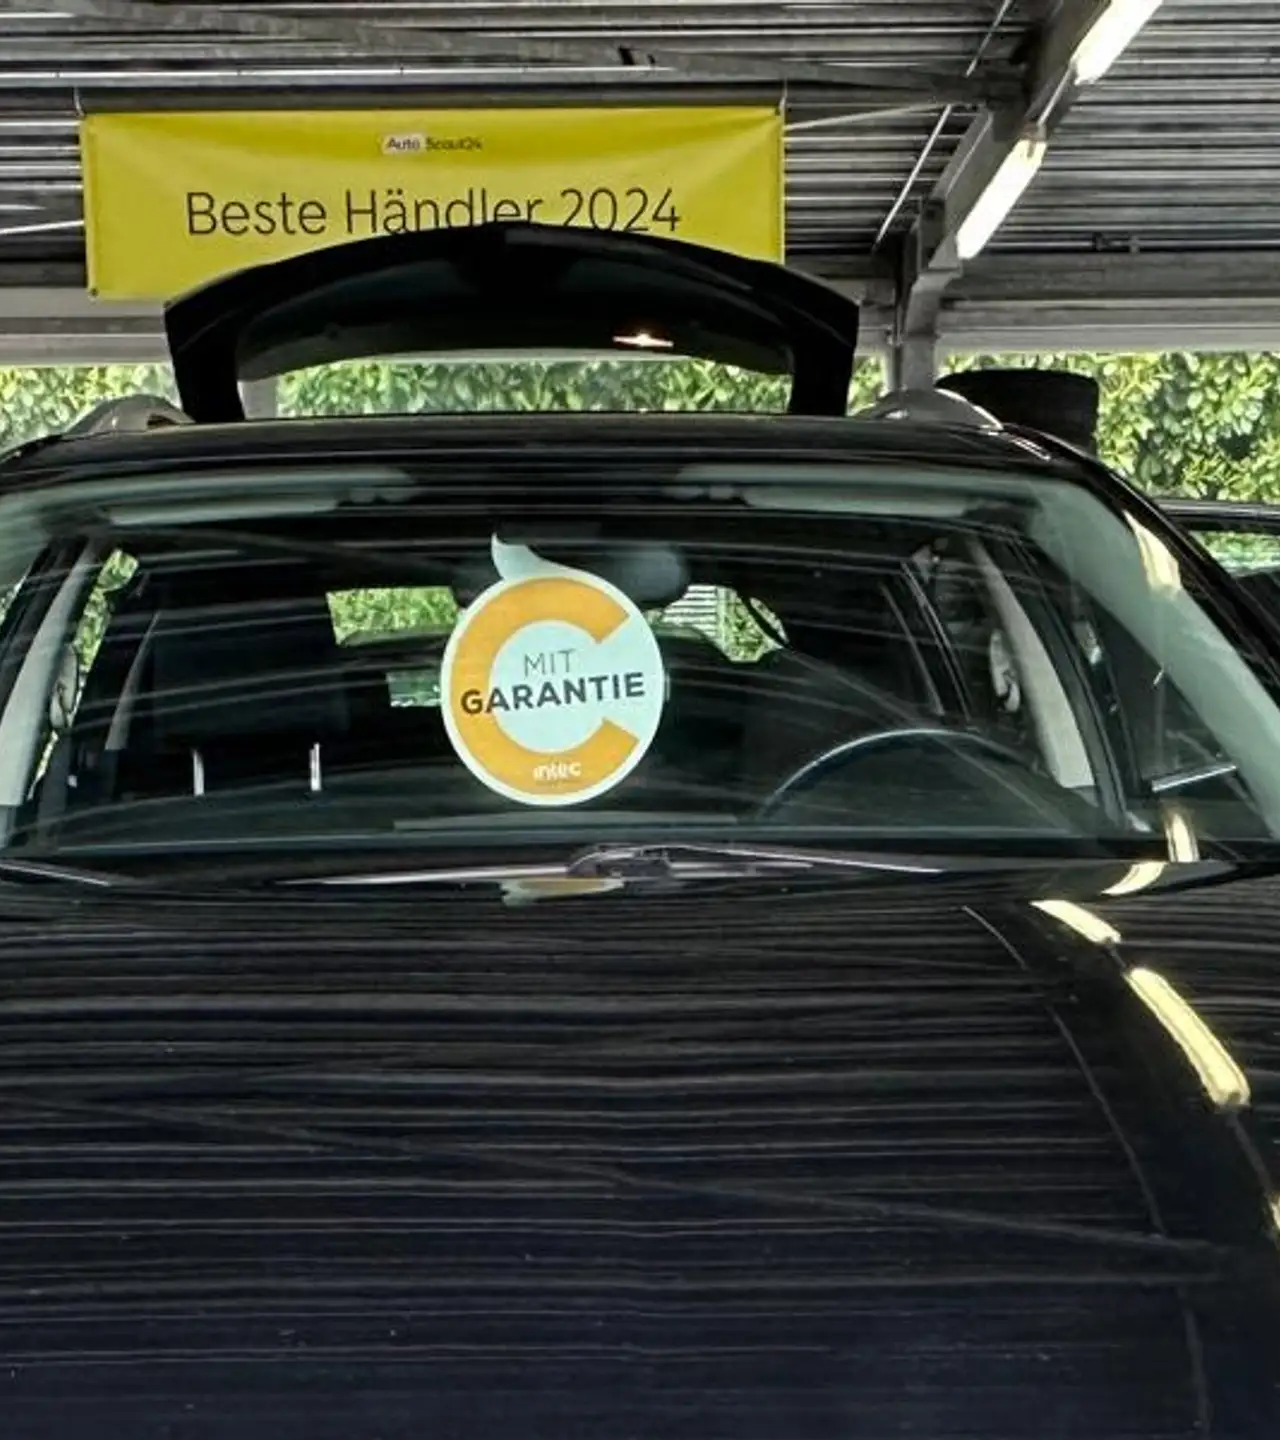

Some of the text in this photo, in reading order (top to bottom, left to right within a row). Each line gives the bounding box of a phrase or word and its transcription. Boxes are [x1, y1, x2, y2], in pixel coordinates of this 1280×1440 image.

[186, 188, 681, 236] Beste Händler 2024
[524, 648, 576, 678] MIT
[460, 672, 645, 716] GARANTIE
